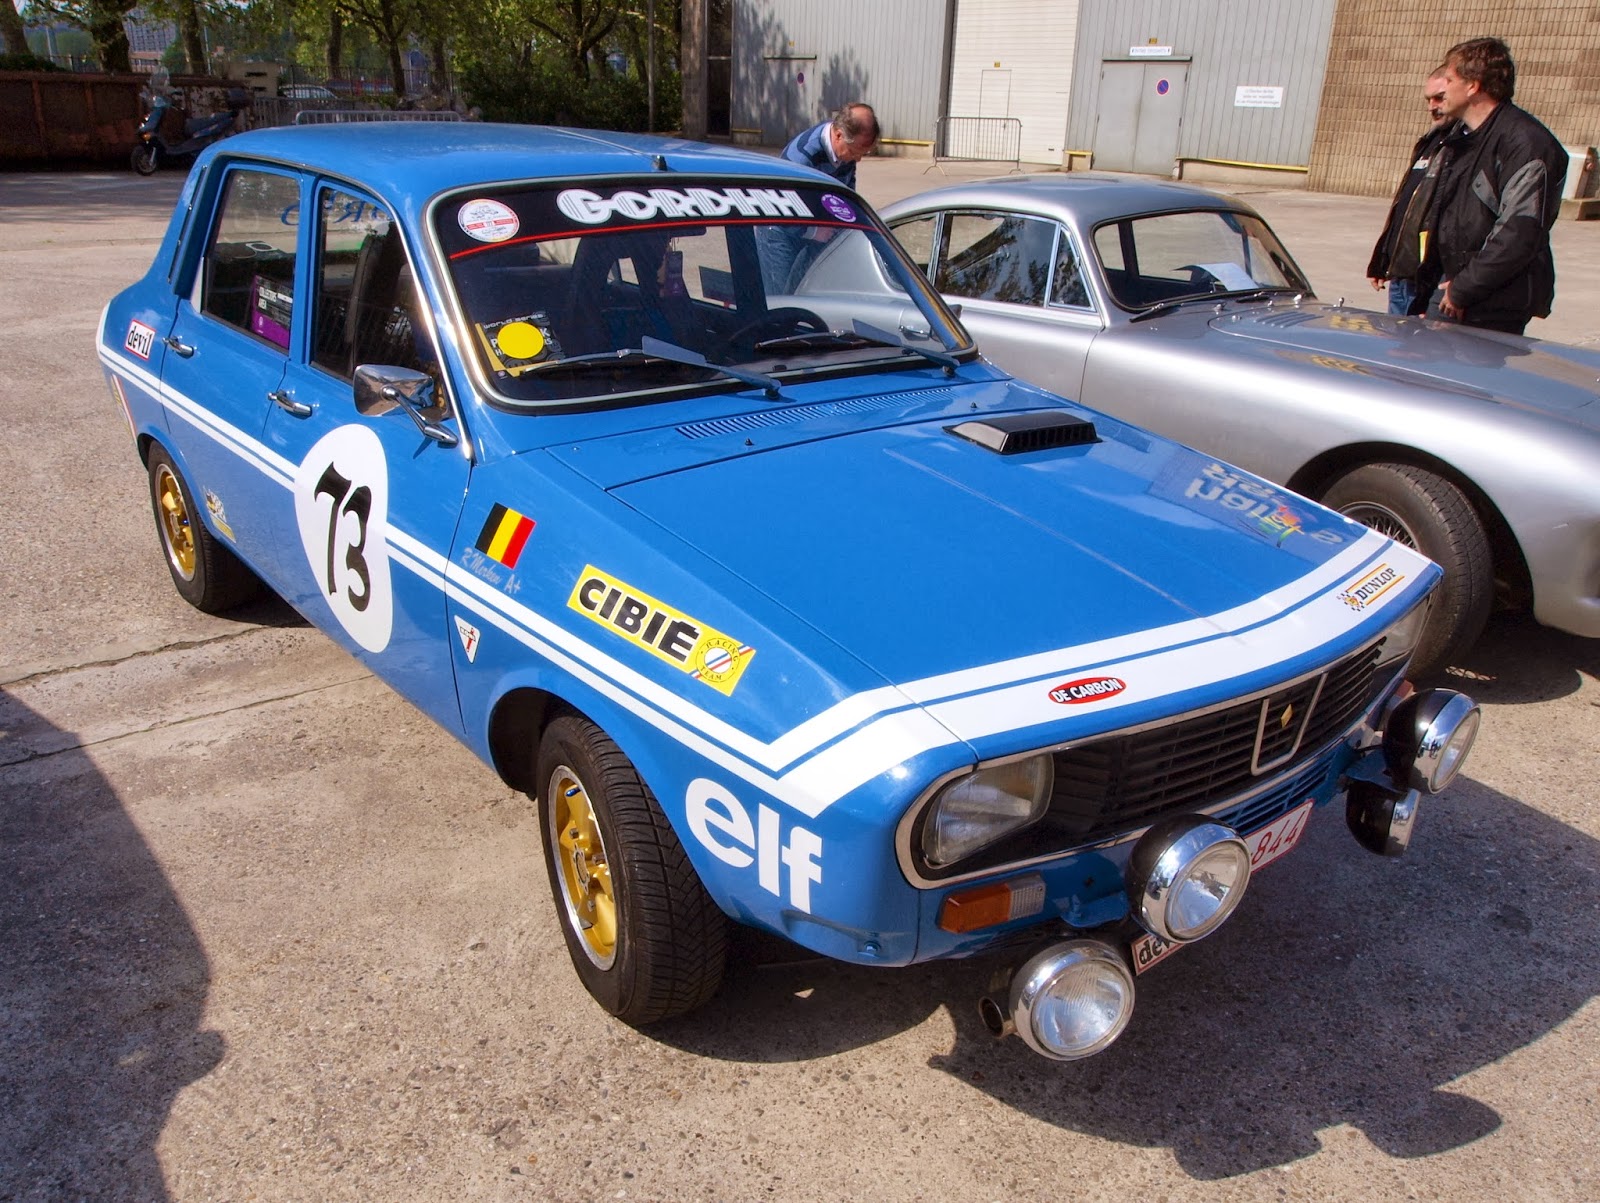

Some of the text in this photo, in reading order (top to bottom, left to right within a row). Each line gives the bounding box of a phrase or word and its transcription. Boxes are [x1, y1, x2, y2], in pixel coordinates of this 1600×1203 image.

[127, 325, 153, 356] devil
[314, 461, 373, 612] 73
[1354, 567, 1397, 601] DUNLOP
[706, 640, 739, 662] RACING
[700, 665, 722, 680] TEAM
[1050, 678, 1124, 703] DE CARBON
[685, 777, 822, 915] elf
